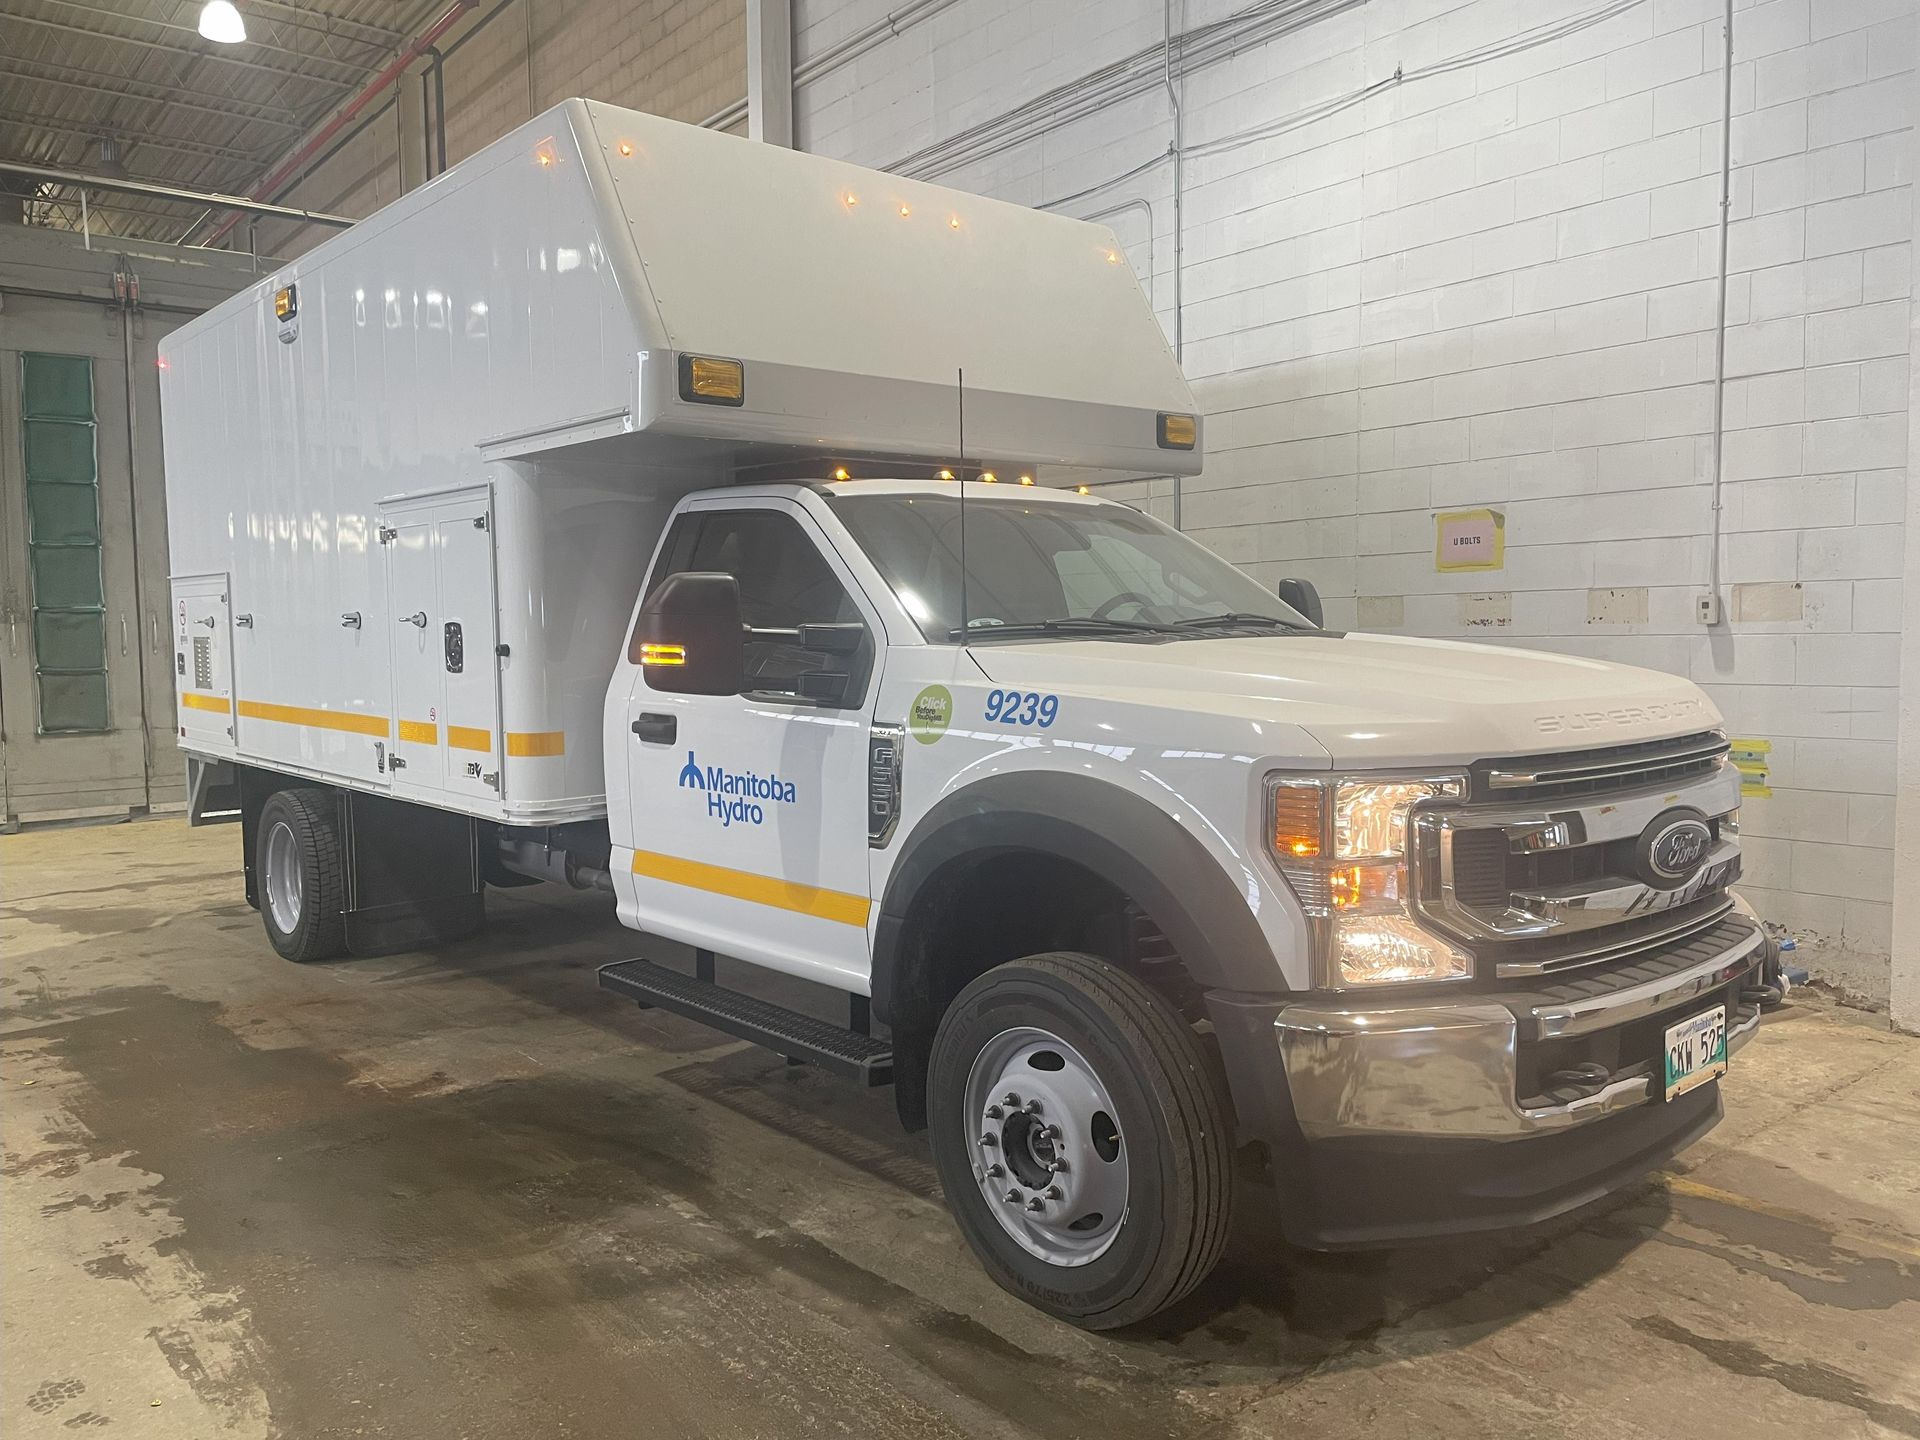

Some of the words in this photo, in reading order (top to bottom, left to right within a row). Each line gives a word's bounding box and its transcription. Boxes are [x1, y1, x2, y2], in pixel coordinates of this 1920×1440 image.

[1453, 537, 1459, 546] U
[1460, 536, 1481, 545] BOLTS
[915, 705, 936, 715] Before
[920, 696, 947, 710] Click
[984, 689, 1059, 728] 9239
[707, 766, 796, 803] Manitoba
[707, 792, 763, 827] Hydro
[1668, 833, 1702, 867] Ford
[1670, 1039, 1693, 1079] CKW
[1700, 1024, 1724, 1065] 525
